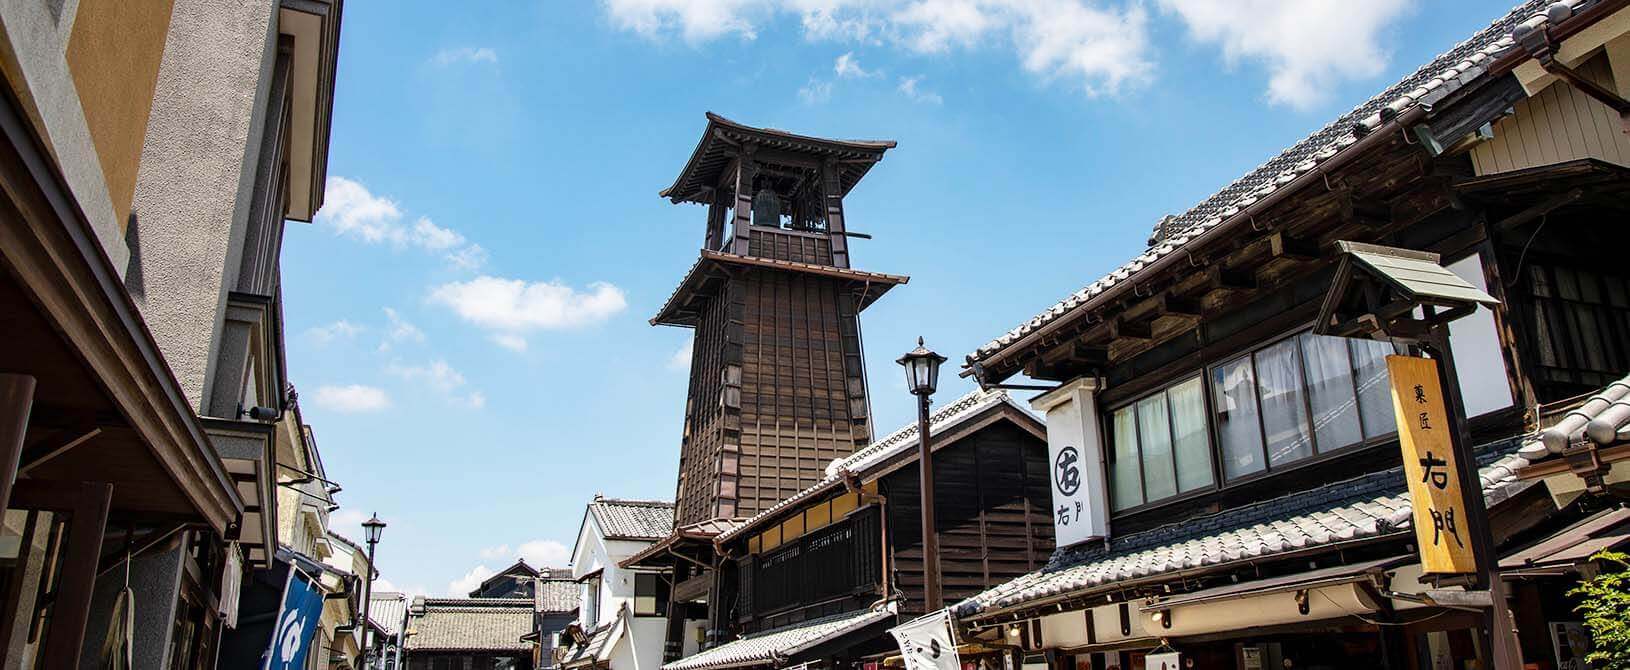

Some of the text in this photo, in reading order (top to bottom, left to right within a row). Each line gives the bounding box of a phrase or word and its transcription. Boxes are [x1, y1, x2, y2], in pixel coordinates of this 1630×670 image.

[1413, 385, 1432, 430] 菓匠
[1057, 450, 1080, 492] 右
[1419, 451, 1465, 549] 右門
